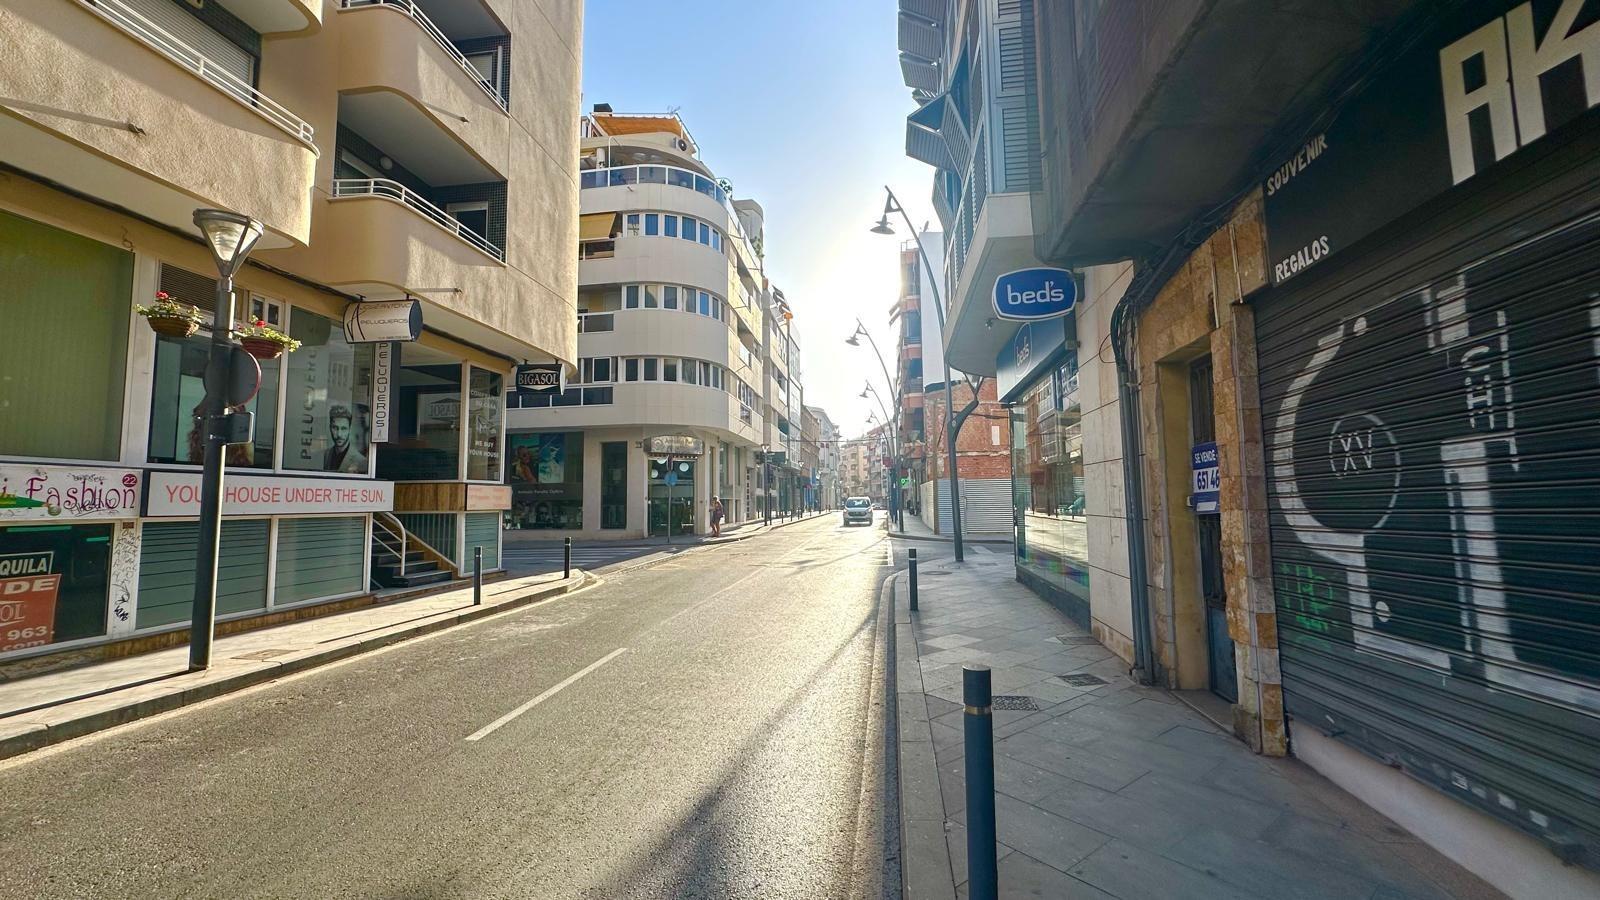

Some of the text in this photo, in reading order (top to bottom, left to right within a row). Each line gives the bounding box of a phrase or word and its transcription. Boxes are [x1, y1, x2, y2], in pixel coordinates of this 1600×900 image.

[1266, 133, 1329, 197] SOUVENIR
[1275, 235, 1331, 283] REGALOS
[1007, 281, 1065, 305] bed's
[375, 342, 389, 428] PELUQUEROS
[518, 373, 559, 385] BIGASOL
[1194, 449, 1217, 464] SE VENDE
[123, 476, 136, 485] 22
[1197, 470, 1209, 490] 651
[25, 474, 136, 512] Fashion
[166, 485, 386, 503] YOU HOUSE UNDER THE SUN.
[0, 577, 56, 595] DE
[7, 625, 48, 641] 963
